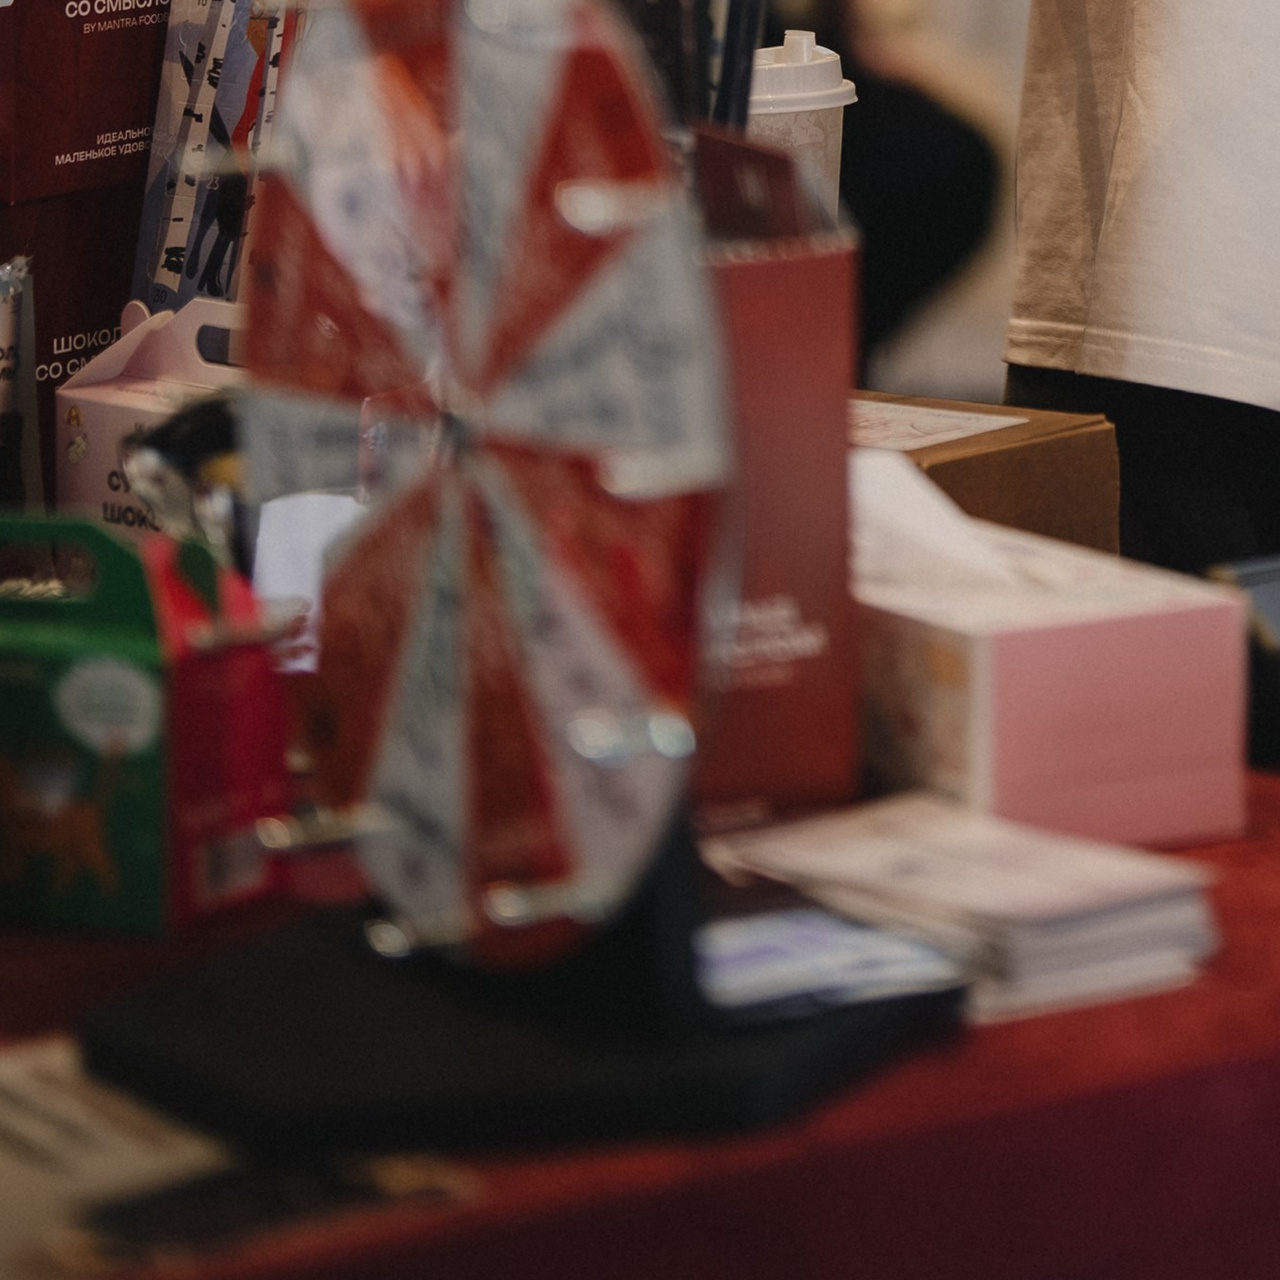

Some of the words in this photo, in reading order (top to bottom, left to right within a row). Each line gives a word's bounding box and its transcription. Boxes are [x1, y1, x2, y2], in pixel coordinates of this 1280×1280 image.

[65, 0, 91, 18] СО
[83, 22, 97, 34] BY
[98, 17, 138, 32] MANTRA
[55, 145, 117, 166] МАЛЕНЬКОЕ
[53, 326, 121, 355] ШОКОЛ
[35, 361, 63, 381] СО
